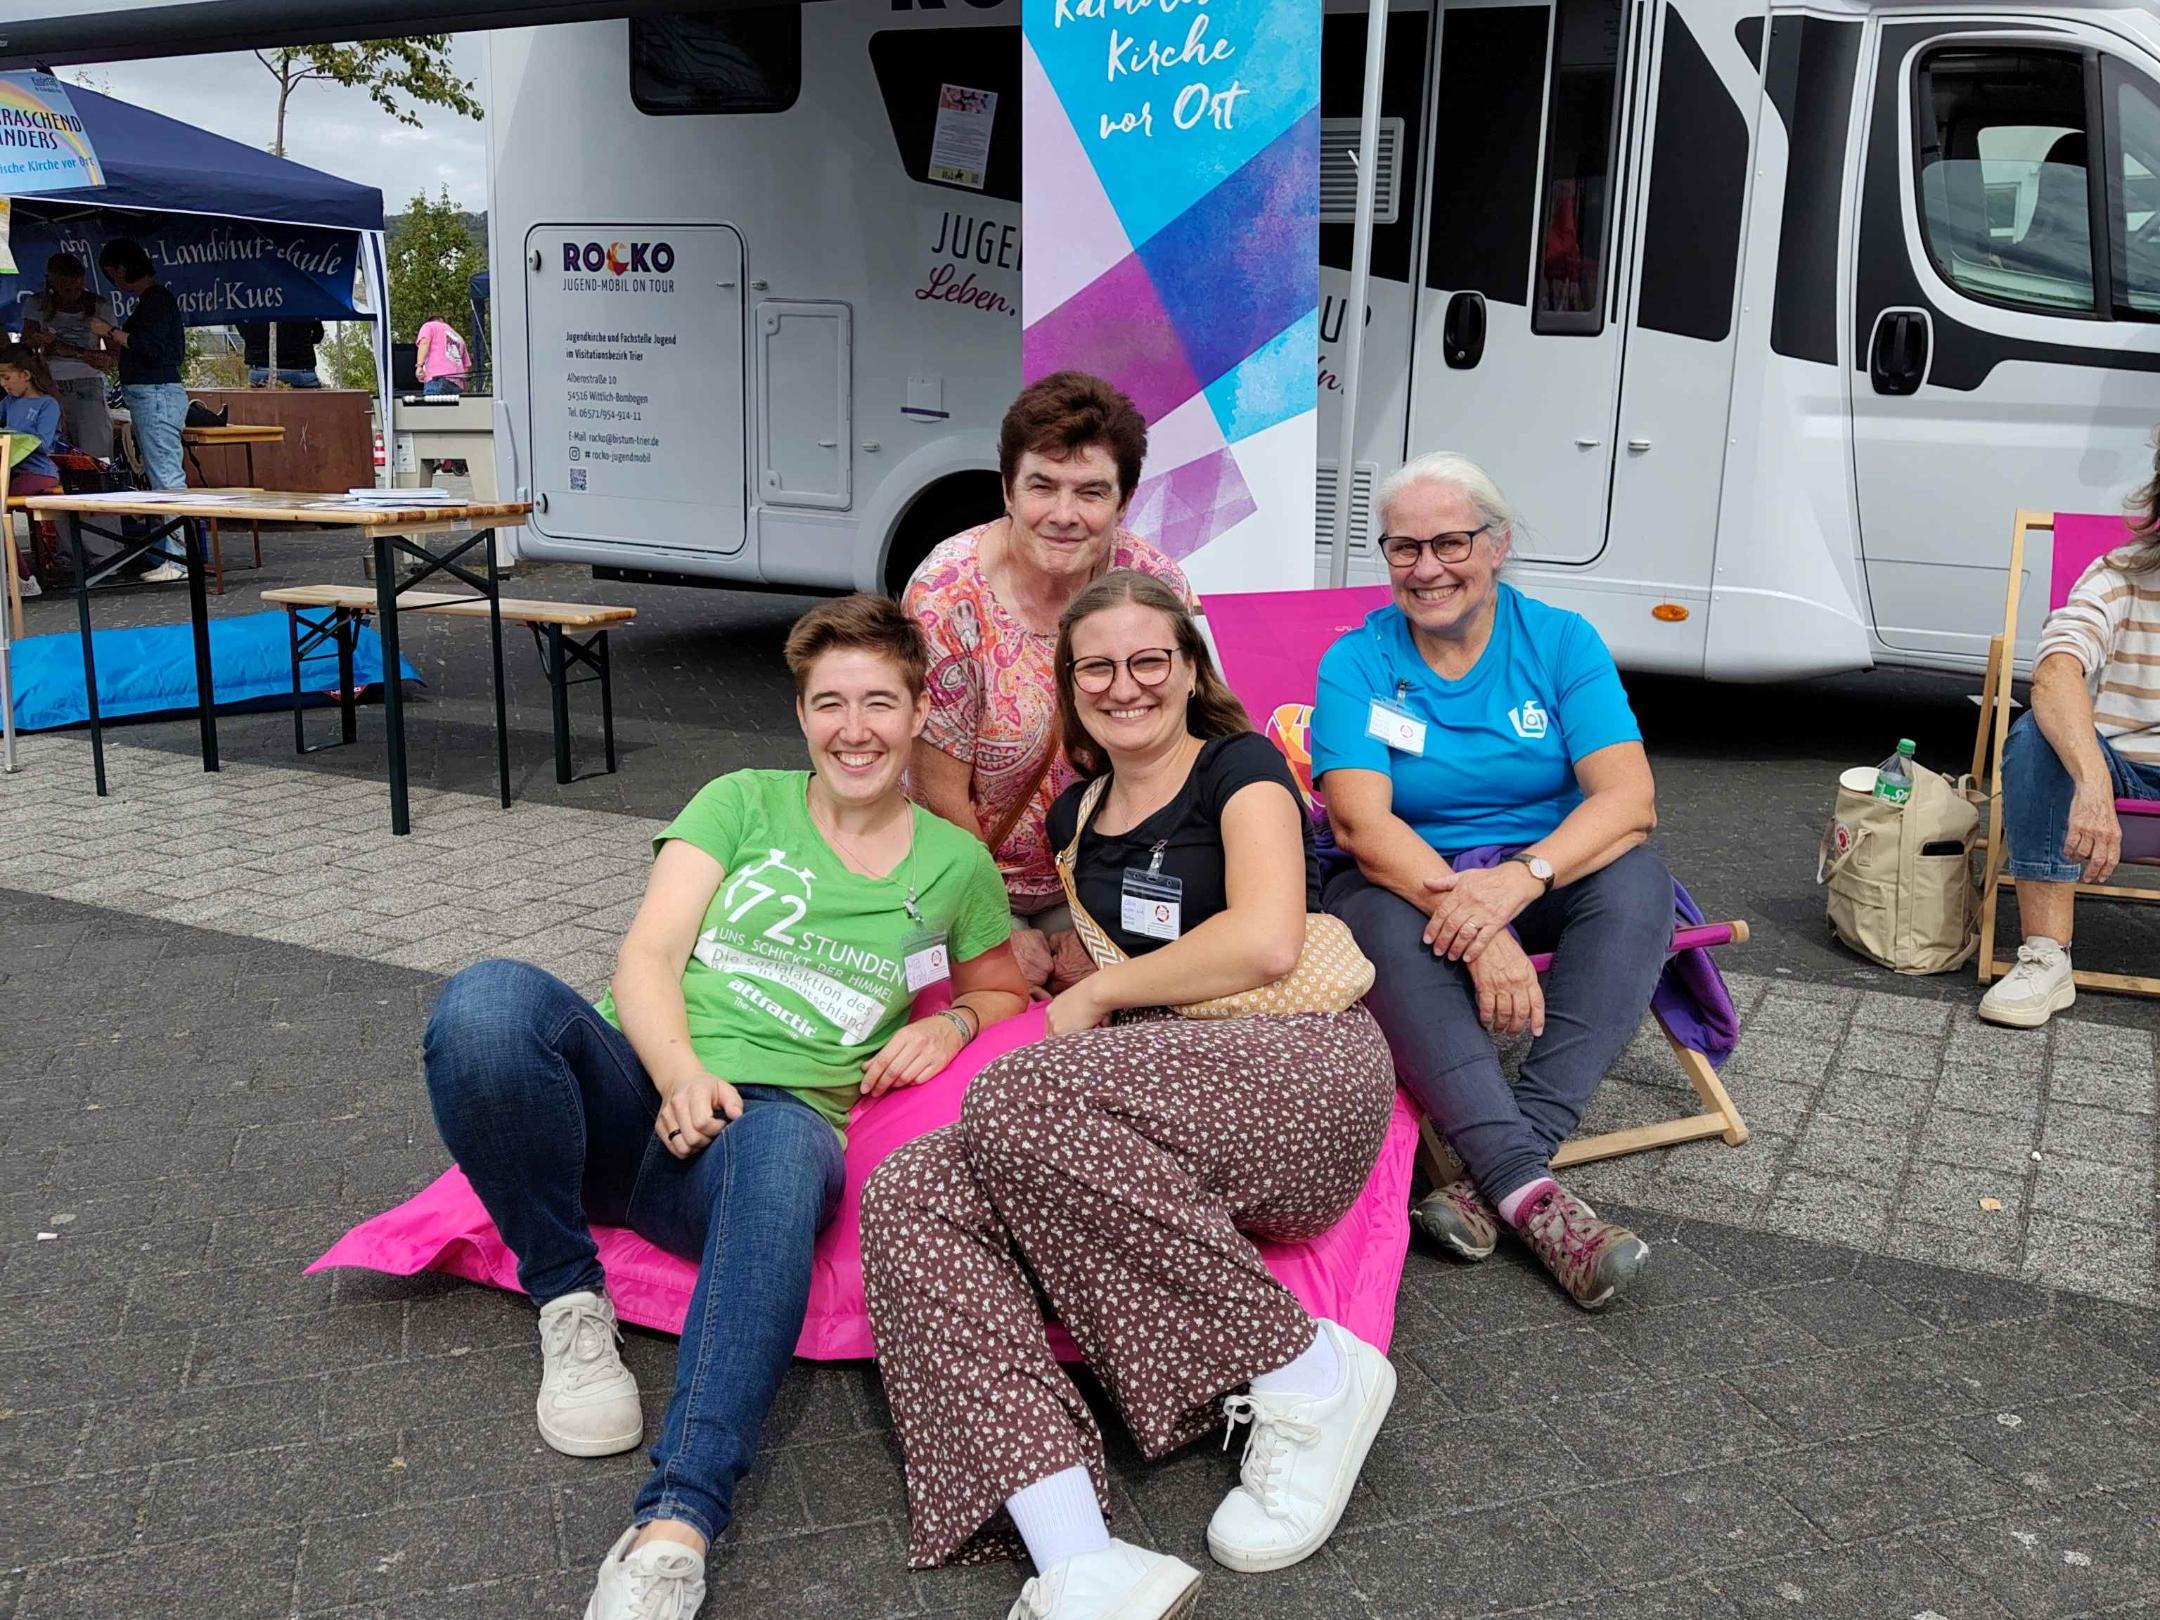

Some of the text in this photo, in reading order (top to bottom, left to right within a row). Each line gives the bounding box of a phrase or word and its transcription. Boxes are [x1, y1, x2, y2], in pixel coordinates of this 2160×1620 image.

[1107, 13, 1236, 82] Kirche
[0, 108, 82, 133] RASCHEND
[1100, 80, 1251, 139] vor Ort
[28, 159, 59, 172] Kirche
[62, 158, 77, 169] vor
[79, 156, 94, 167] Ort
[563, 242, 675, 275] ROCKO
[111, 277, 283, 318] Beastel-Kues
[563, 278, 675, 293] JUGEND-MOBIL ON TOUR
[915, 263, 1015, 316] Leben.
[566, 331, 677, 346] Jugendkirche und Fachstelle Jugend
[566, 348, 644, 361] im Visitationsbezirk Trier
[567, 391, 588, 401] 54516
[608, 376, 617, 385] 10
[727, 879, 807, 946] 72
[719, 928, 745, 946] UNS
[751, 939, 812, 967] SCHICKT
[816, 963, 844, 979] DER
[799, 932, 906, 987] STUNDEN
[711, 948, 739, 963] Die
[847, 996, 874, 1017] des
